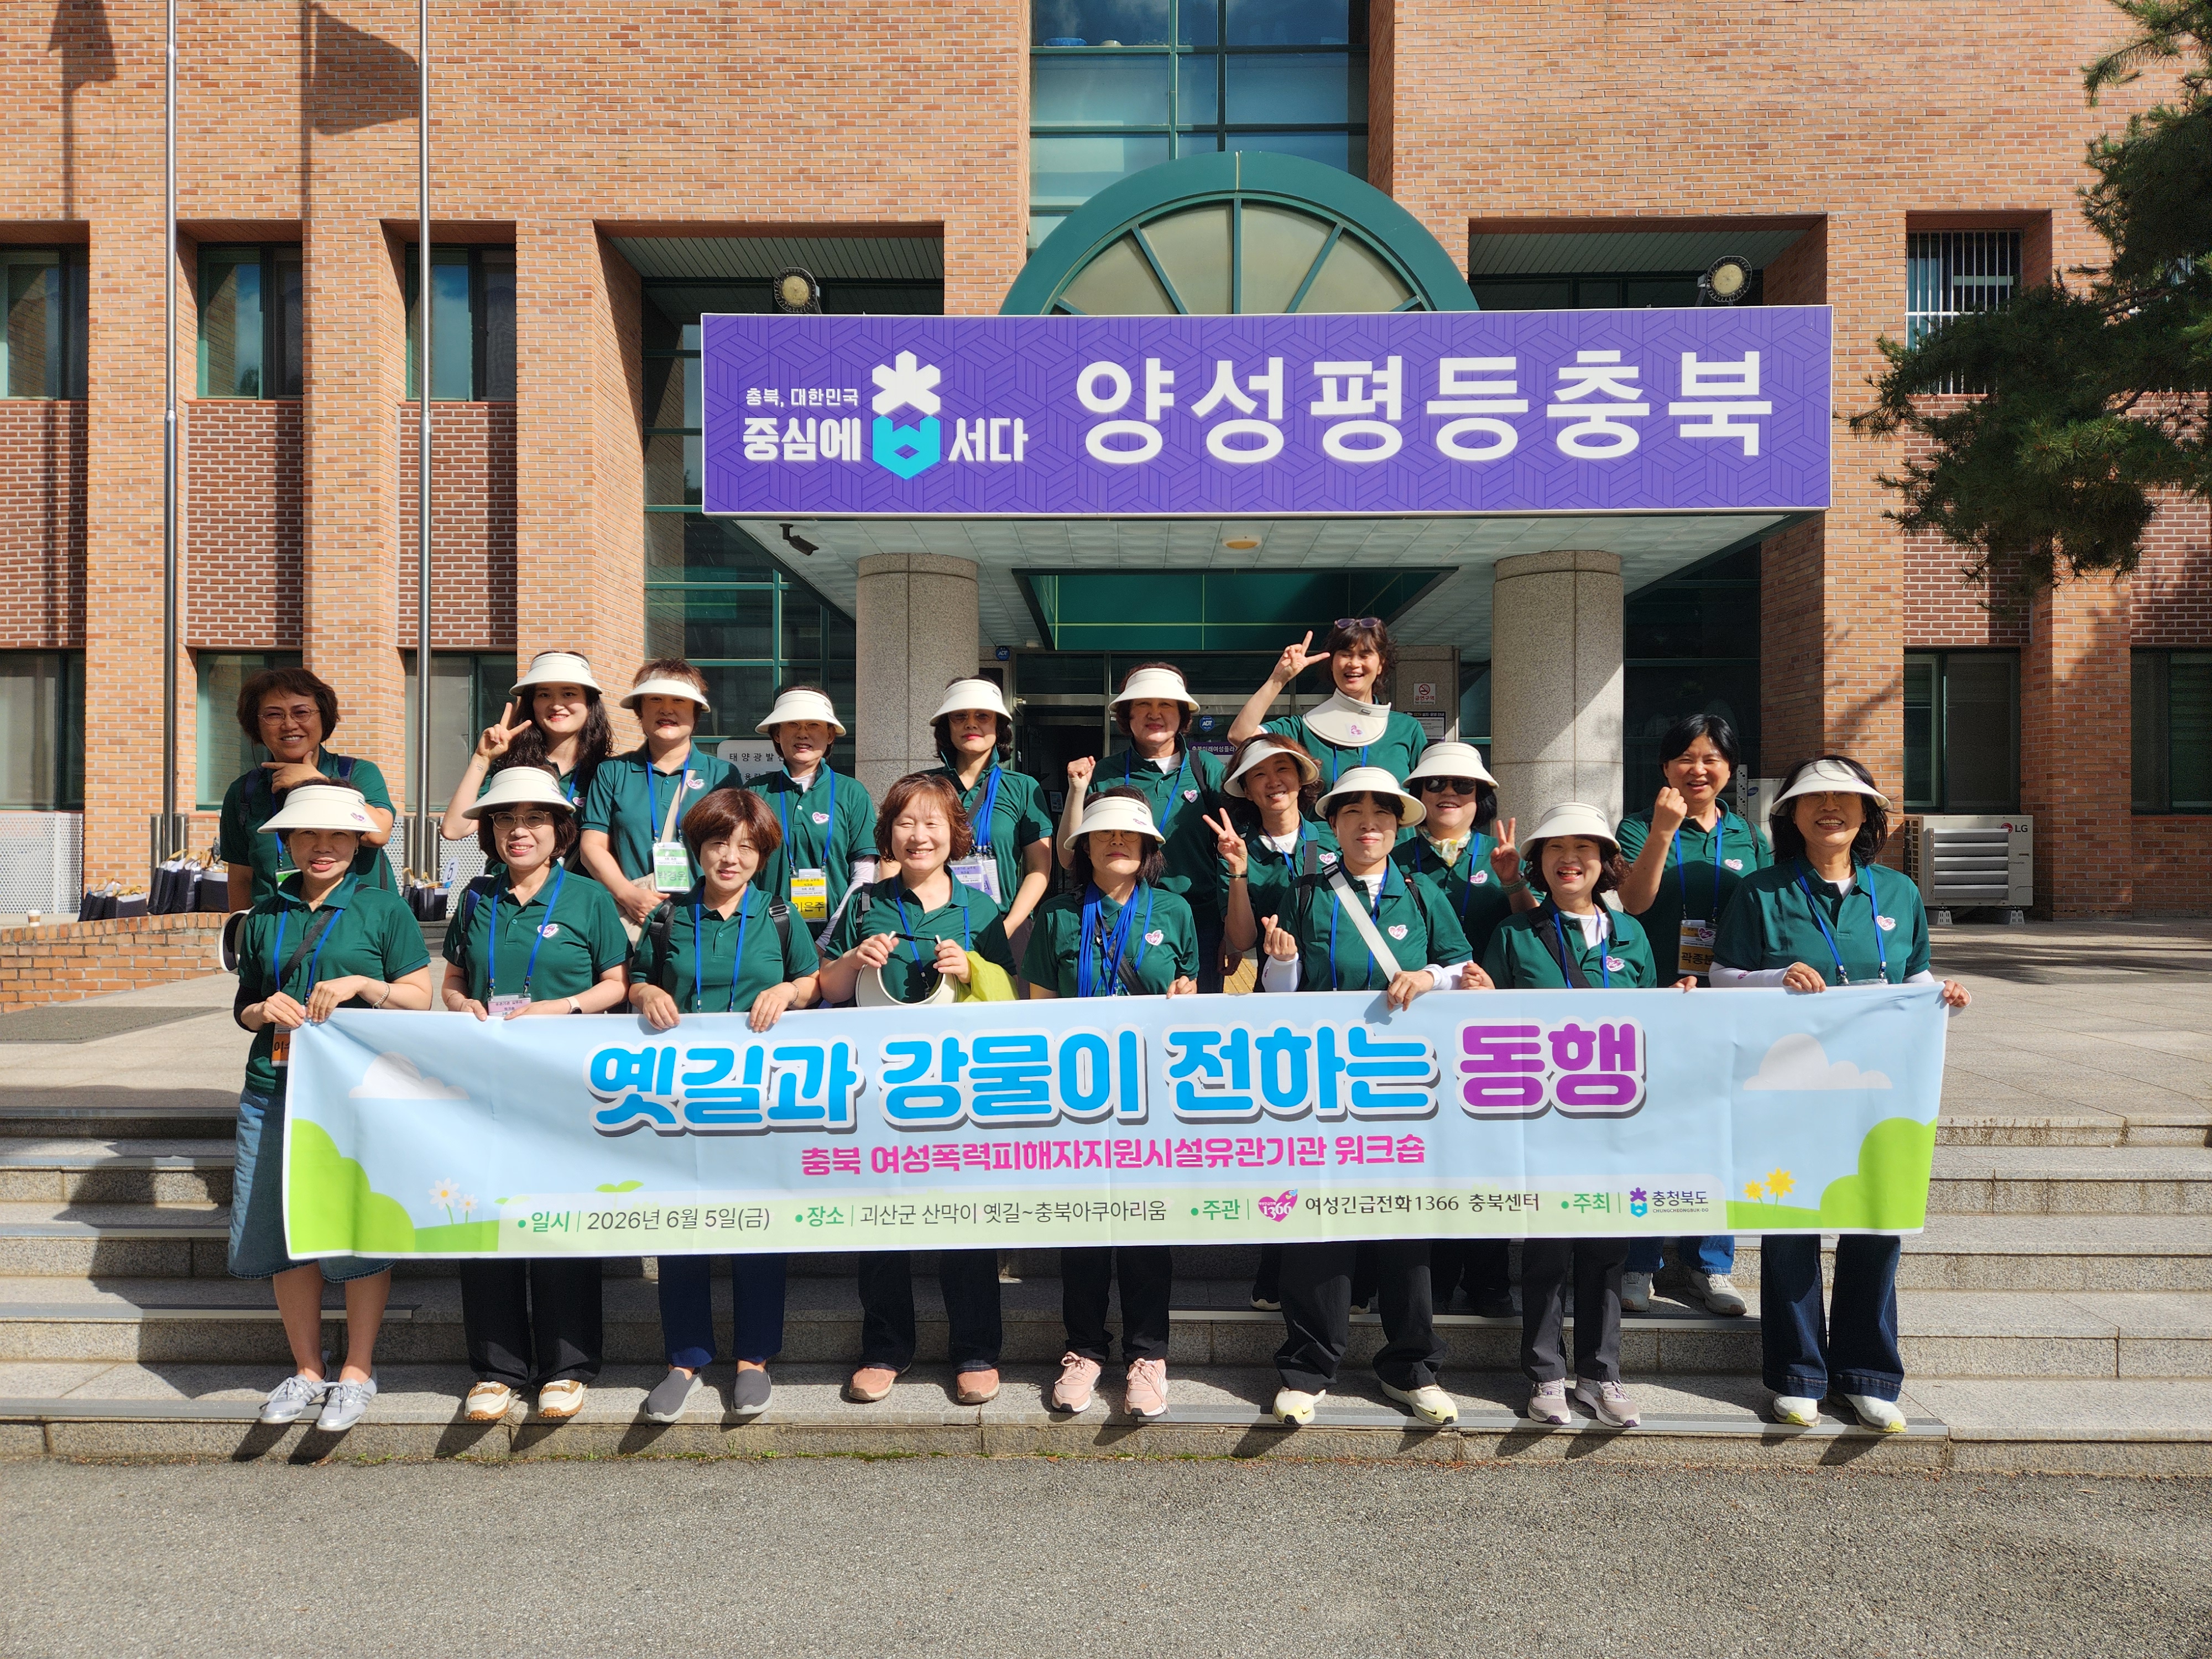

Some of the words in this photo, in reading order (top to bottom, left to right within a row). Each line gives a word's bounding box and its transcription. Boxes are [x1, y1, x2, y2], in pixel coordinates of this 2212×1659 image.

[745, 387, 785, 408] 충북,
[790, 388, 859, 406] 대한민국
[742, 416, 862, 461] 중심에
[947, 416, 1029, 461] 서다
[2015, 824, 2028, 833] LG
[447, 862, 455, 880] 5
[587, 1040, 860, 1127] 옛길과
[880, 1029, 1141, 1120] 강물이
[1166, 1023, 1433, 1112] 전하는
[1457, 1020, 1640, 1109] 동행
[801, 1146, 862, 1176] 충북
[870, 1135, 1327, 1173] 여성폭력피해자지원시설유관기관
[1334, 1134, 1426, 1165] 워크숍
[807, 1206, 845, 1227] 장소
[860, 1204, 917, 1226] 괴산군
[922, 1202, 977, 1224] 산막이
[983, 1200, 1167, 1224] 옛길~충북아쿠아리움
[1202, 1198, 1241, 1220] 주관
[1305, 1193, 1460, 1216] 여성긴급전화1366
[1468, 1193, 1540, 1213] 충북센터
[1262, 1202, 1292, 1219] 1366
[1573, 1192, 1610, 1213] 주최
[1651, 1190, 1709, 1207] 충청북도
[531, 1211, 571, 1233] 일시
[587, 1209, 660, 1230] 2026년
[666, 1208, 698, 1229] 6월
[705, 1207, 770, 1232] 5일(금)
